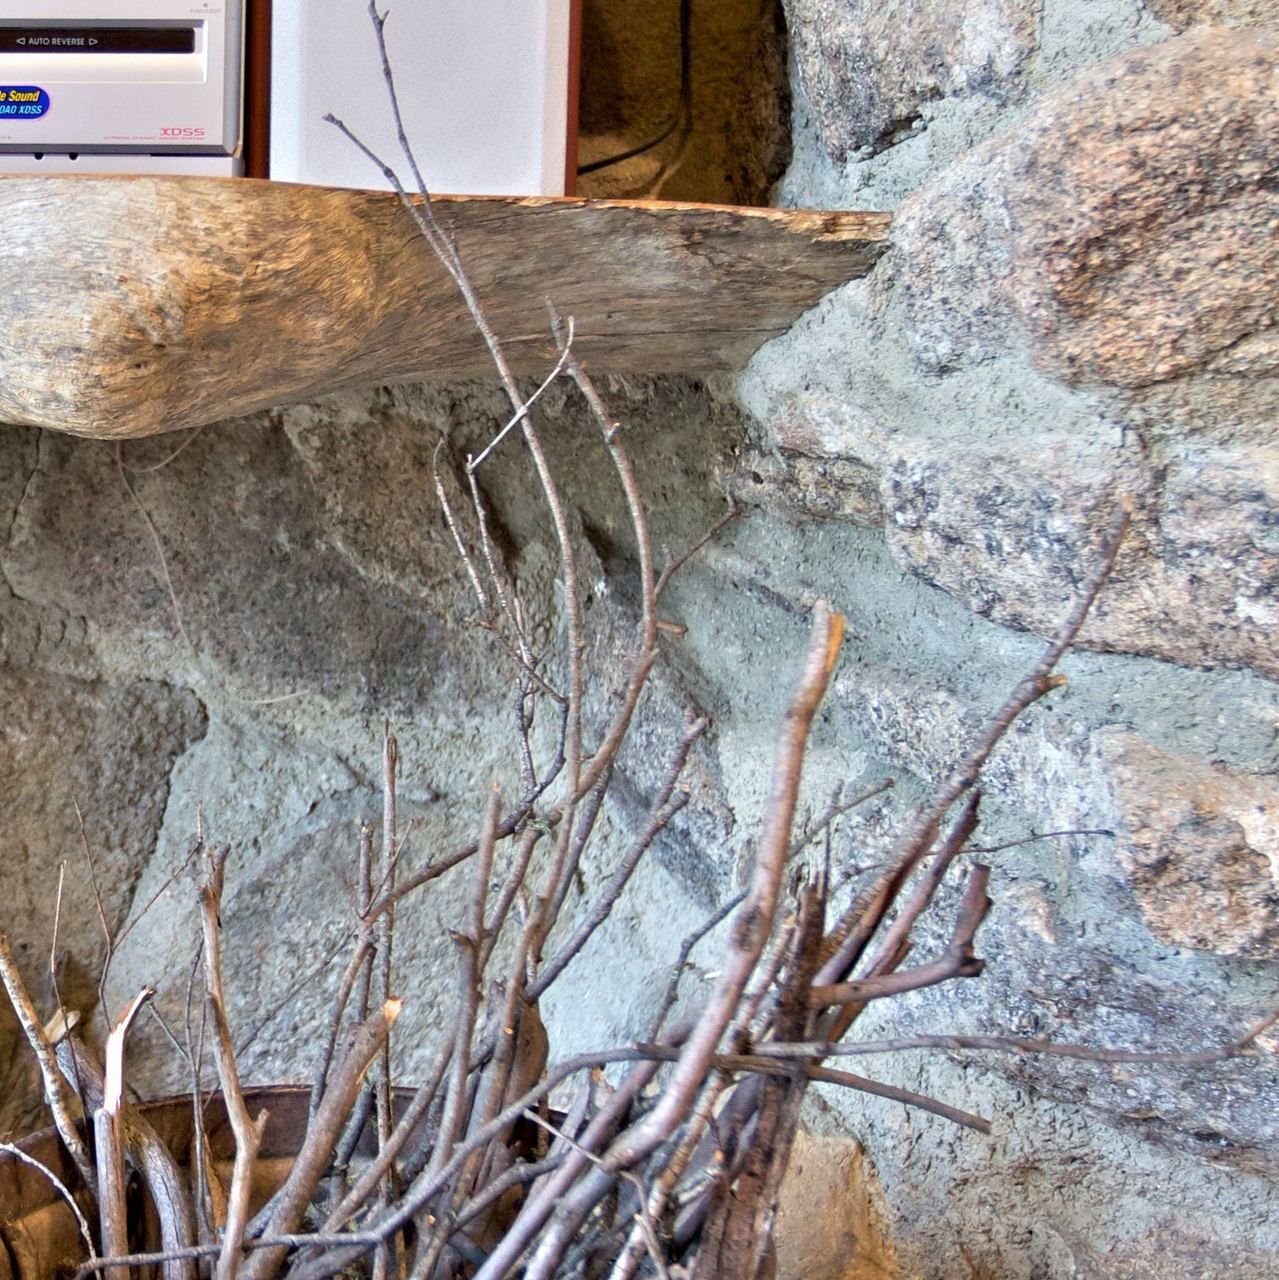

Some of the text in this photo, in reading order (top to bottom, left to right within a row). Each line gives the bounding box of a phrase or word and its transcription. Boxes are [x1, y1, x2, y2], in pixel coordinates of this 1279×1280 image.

[28, 37, 85, 46] AUTO REVERSE
[8, 90, 40, 102] Sound
[18, 104, 43, 115] XDSS
[160, 127, 206, 136] XDSS
